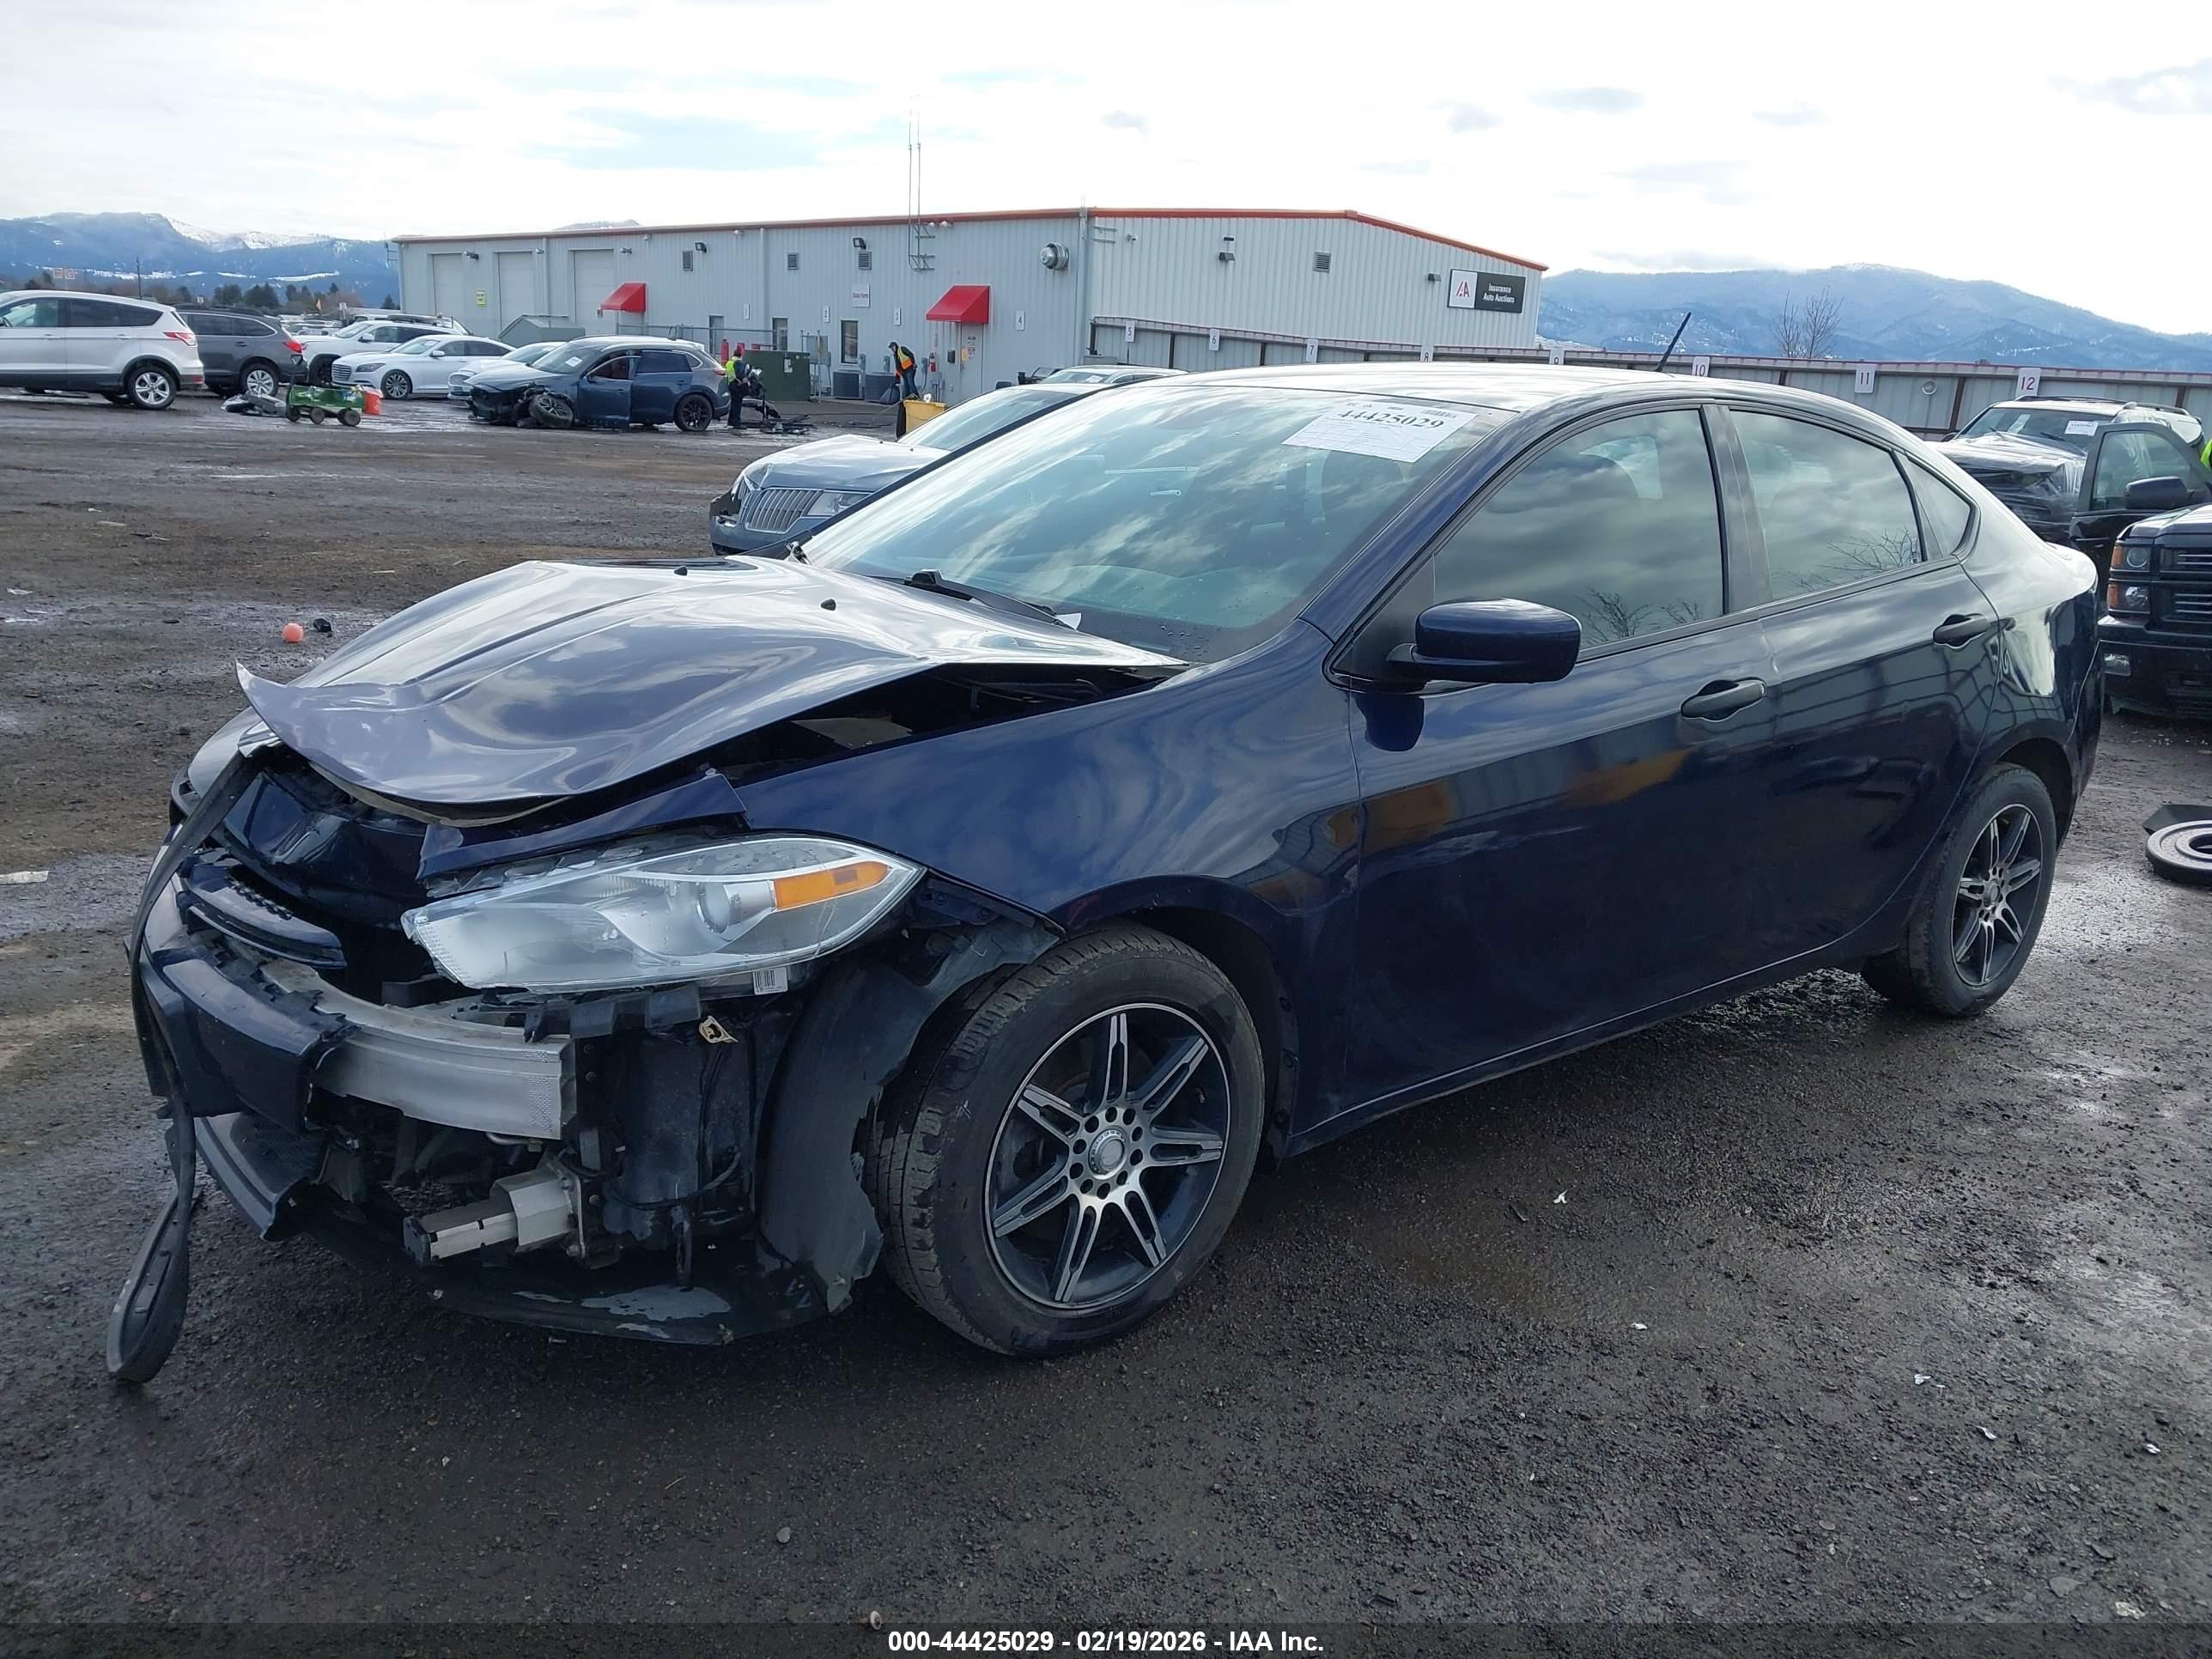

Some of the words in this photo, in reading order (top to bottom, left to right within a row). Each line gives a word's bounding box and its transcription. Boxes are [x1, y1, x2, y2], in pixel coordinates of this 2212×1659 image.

[1488, 283, 1512, 294] Insurance
[1482, 292, 1495, 301] Auto
[1495, 293, 1515, 303] Auctions
[1127, 326, 1132, 336] 5
[1212, 335, 1217, 343] 6
[1310, 345, 1314, 355] 7
[1695, 364, 1705, 377] 10
[1860, 371, 1869, 386] 11
[2021, 376, 2035, 391] 12
[1337, 410, 1445, 428] 44425029
